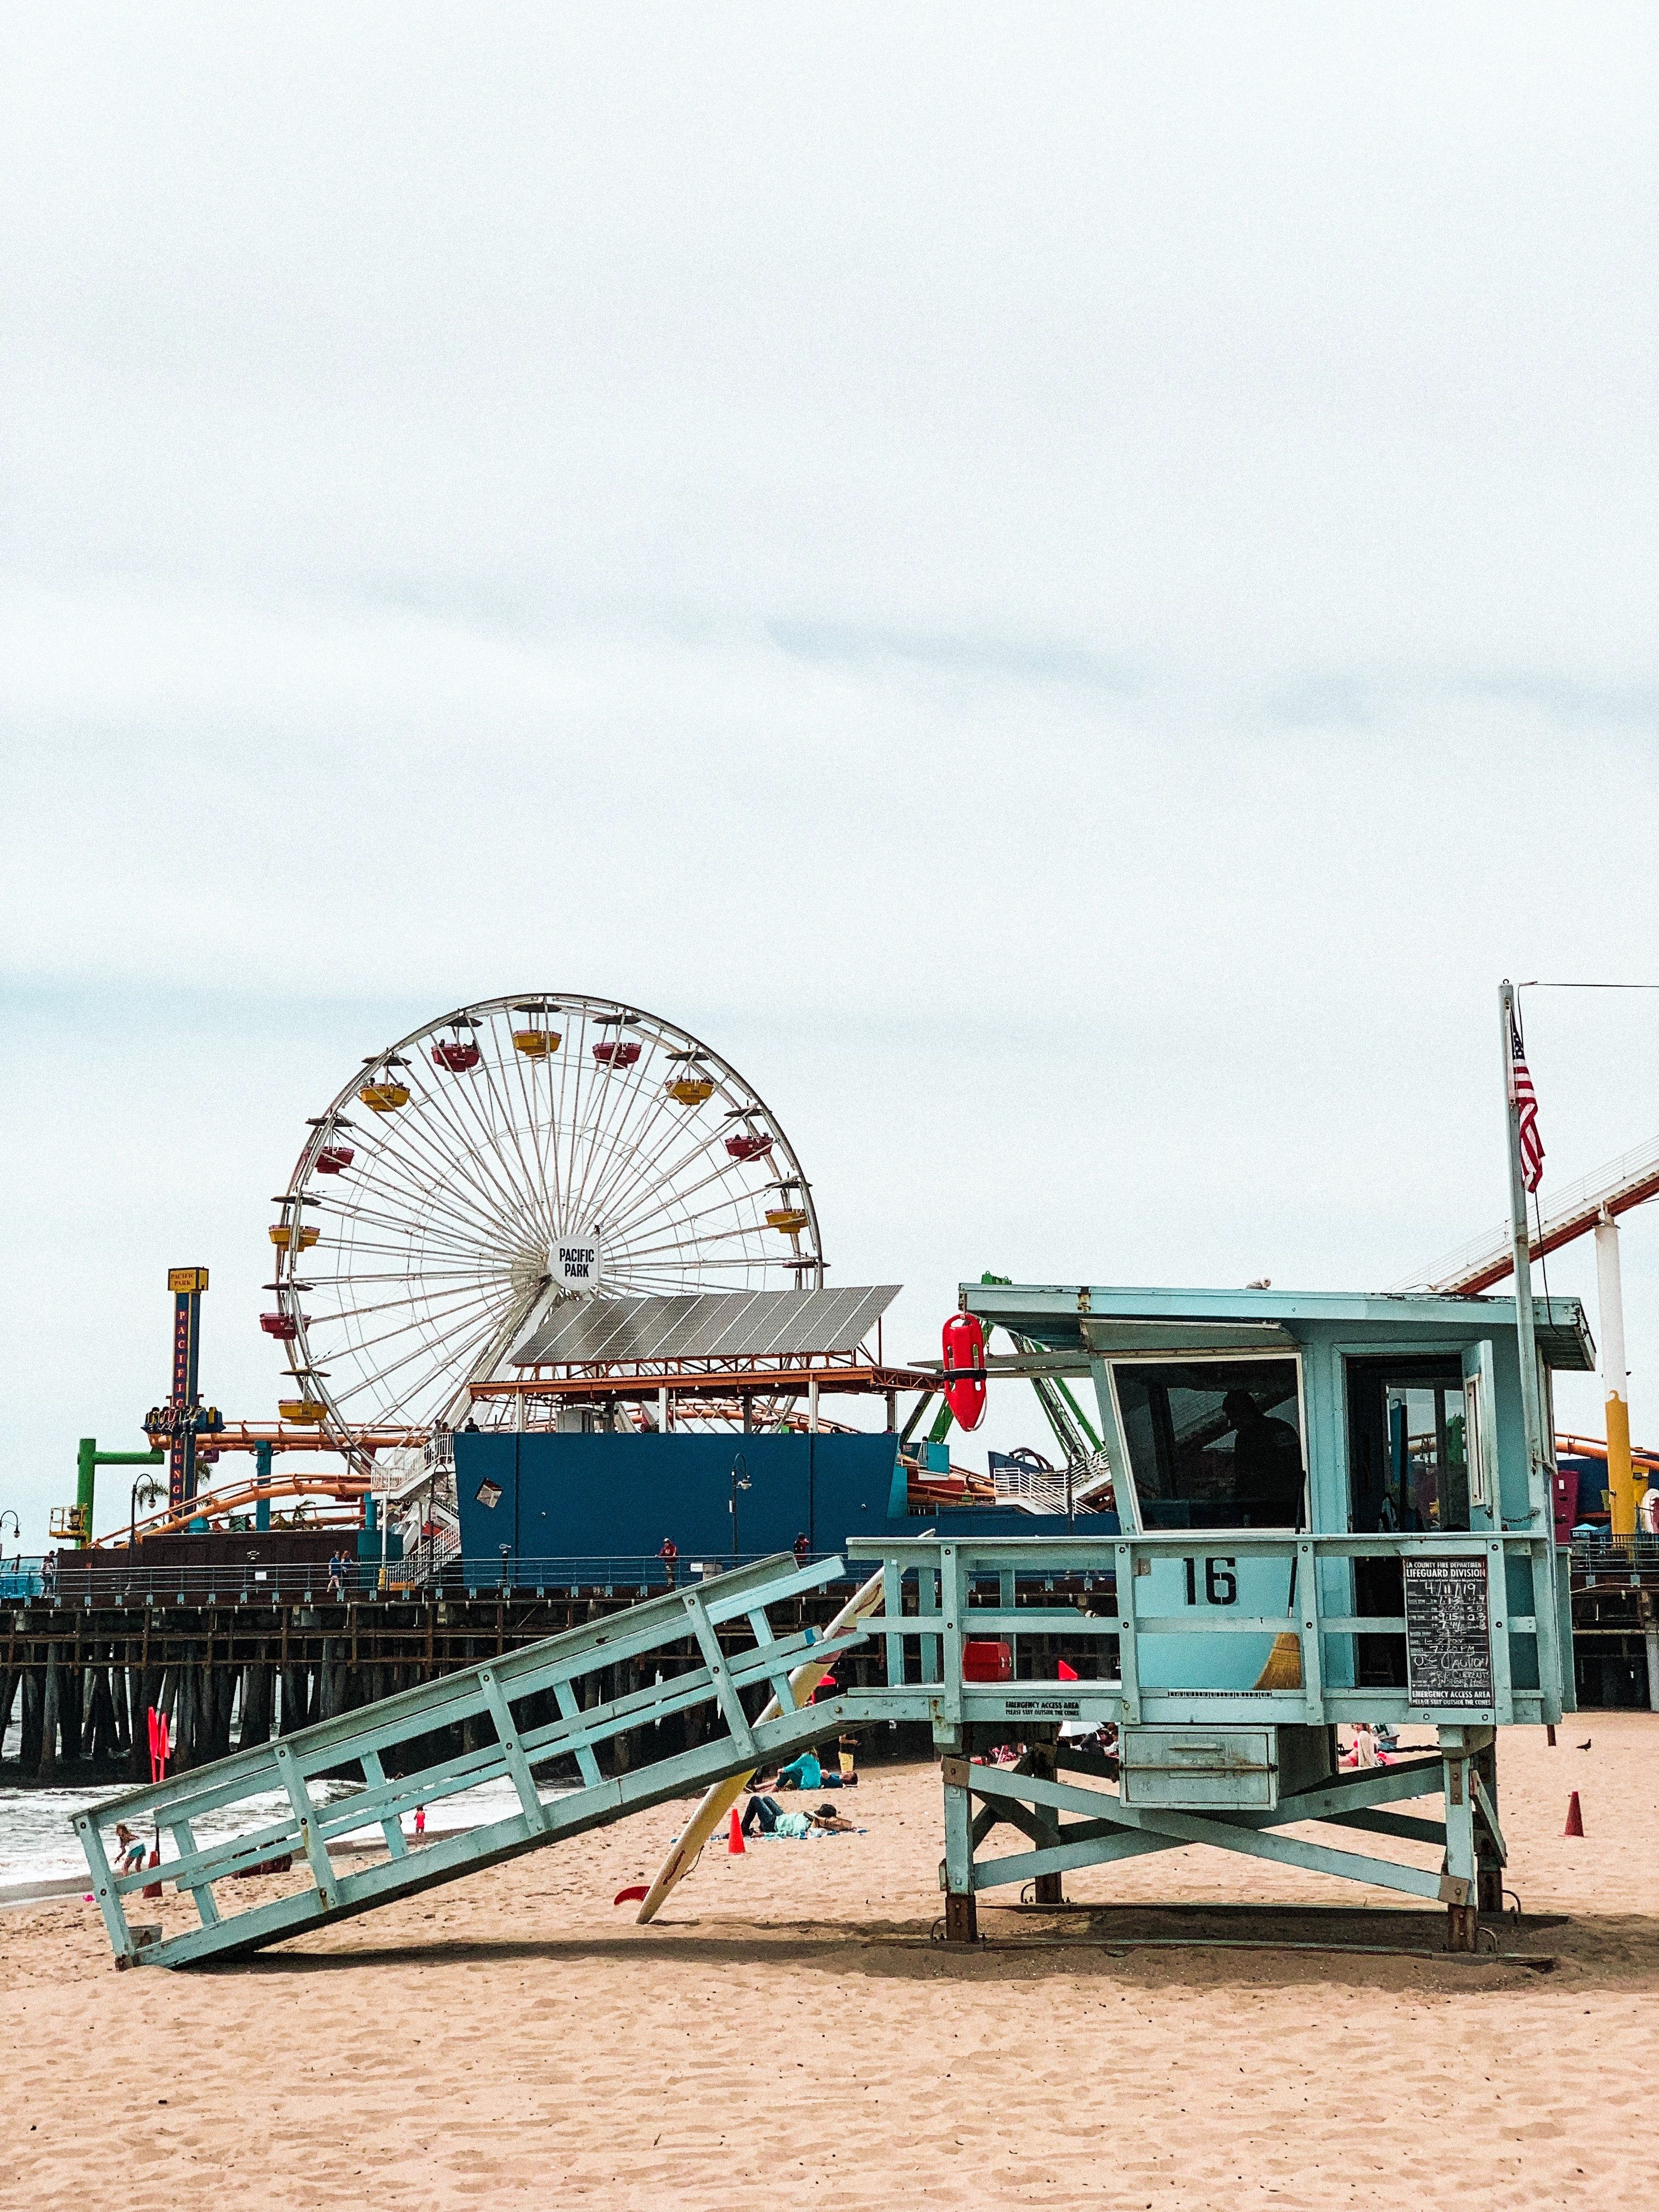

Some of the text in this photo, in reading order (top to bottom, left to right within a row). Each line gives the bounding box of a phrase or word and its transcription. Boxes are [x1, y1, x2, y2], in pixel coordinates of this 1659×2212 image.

[560, 1248, 594, 1262] PACIFIC
[565, 1263, 589, 1277] PARK
[176, 1311, 186, 1408] PACIFIC
[1406, 1568, 1486, 1577] LIFEGUARD DIVISION
[1183, 1556, 1237, 1605] 16
